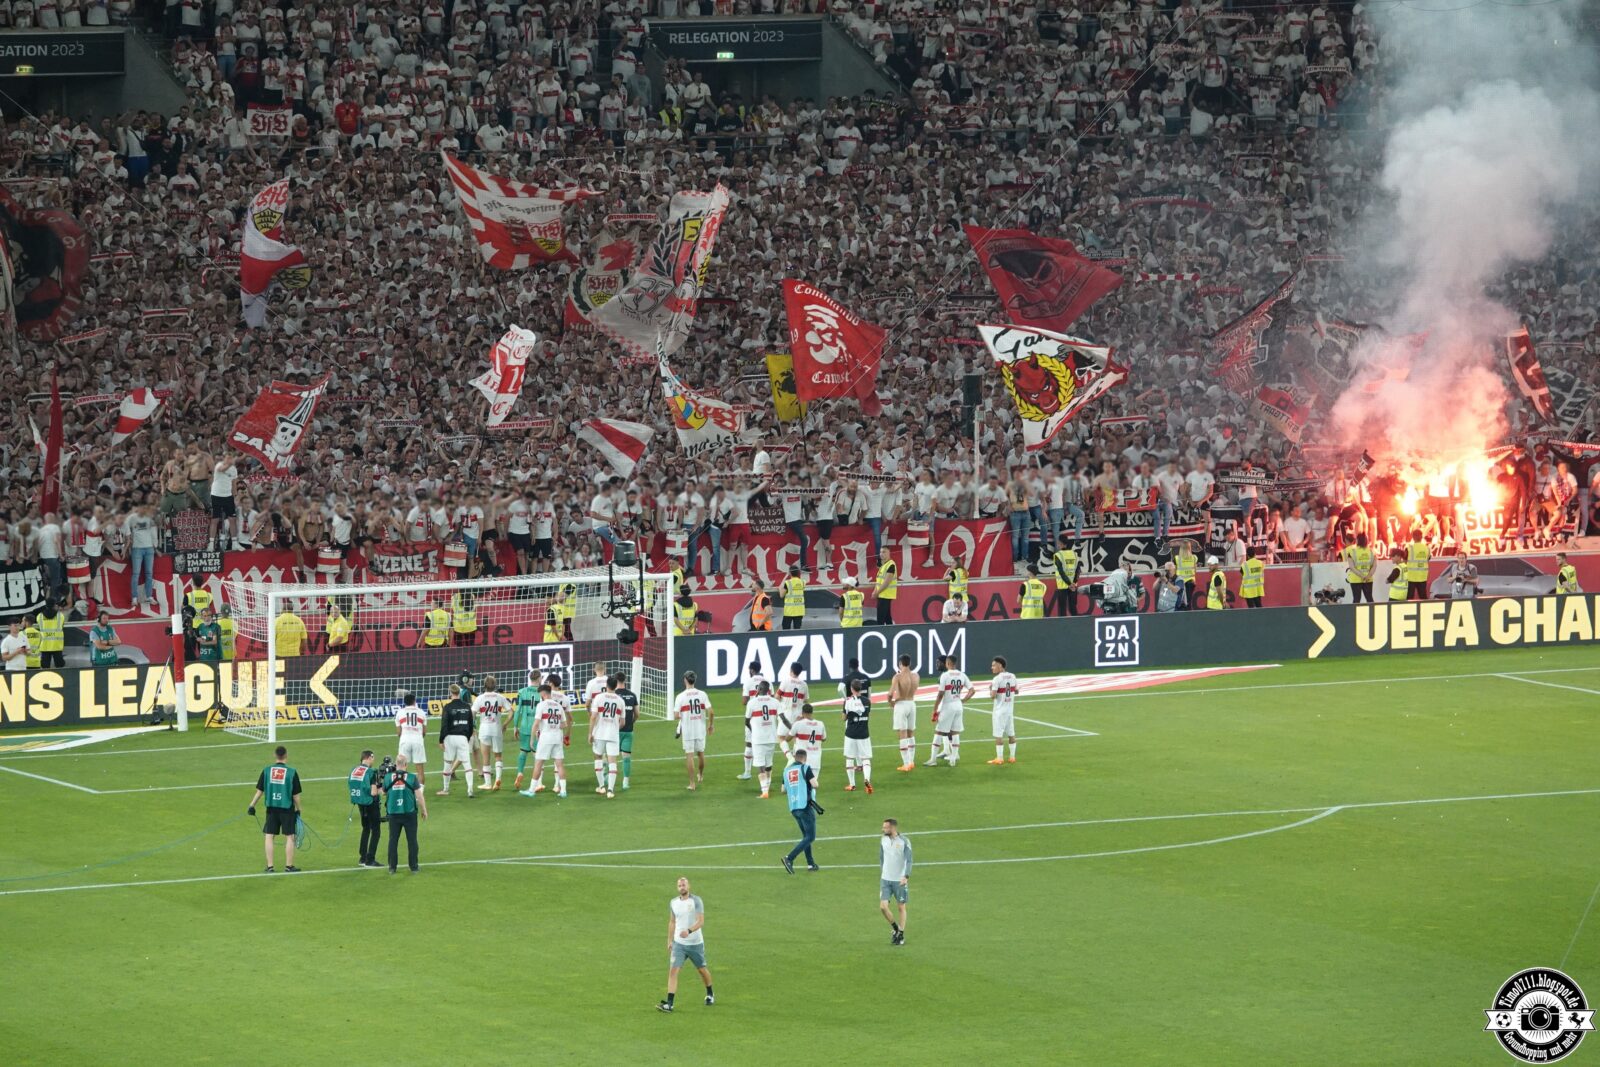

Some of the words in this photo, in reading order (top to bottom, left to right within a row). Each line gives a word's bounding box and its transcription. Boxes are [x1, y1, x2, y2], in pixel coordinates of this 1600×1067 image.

[669, 31, 750, 44] RELEGATION
[753, 30, 784, 43] 2023
[51, 43, 85, 56] 2023
[846, 473, 897, 482] COMMANDO
[941, 519, 1008, 582] 97
[1356, 601, 1479, 652] UEFA
[1490, 595, 1600, 645] CHA
[1105, 625, 1130, 640] DA
[706, 633, 844, 686] DAZN
[858, 627, 966, 678] COM
[1105, 643, 1129, 658] ZN
[538, 653, 563, 669] DA
[79, 658, 286, 719] LEAGUE
[300, 706, 338, 720] BET
[484, 700, 498, 717] 24
[603, 701, 617, 718] 20
[689, 698, 700, 714] 16
[762, 704, 769, 721] 9
[406, 712, 417, 727] 10
[547, 708, 559, 725] 25
[809, 730, 816, 745] 4
[351, 789, 361, 797] 28
